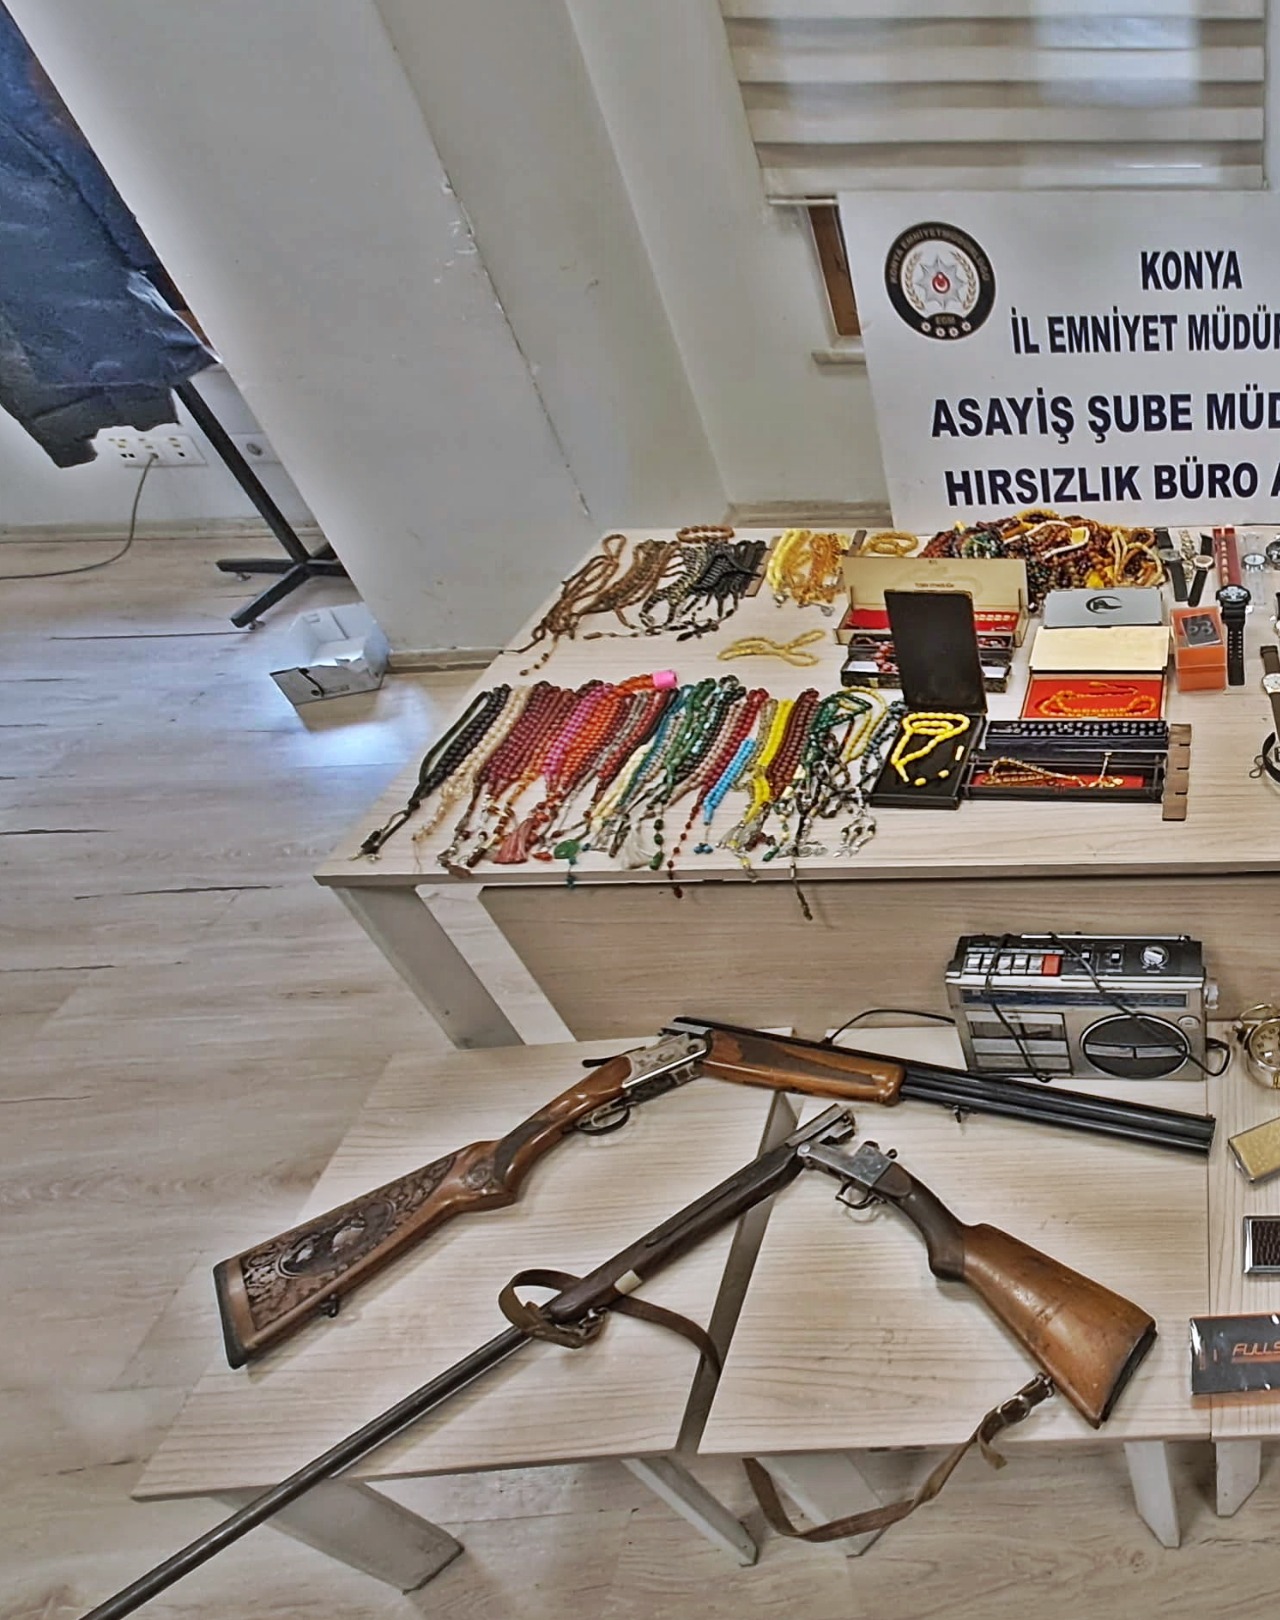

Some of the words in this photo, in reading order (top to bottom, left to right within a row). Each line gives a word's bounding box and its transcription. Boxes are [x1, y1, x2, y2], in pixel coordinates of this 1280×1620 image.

[1139, 250, 1242, 291] KONYA
[1011, 305, 1040, 354] İL
[1047, 304, 1178, 354] EMNİYET
[931, 387, 1075, 445] ASAYİŞ
[1088, 393, 1194, 444] ŞUBE
[943, 465, 1143, 507] HIRSIZLIK
[1153, 455, 1259, 501] BÜRO
